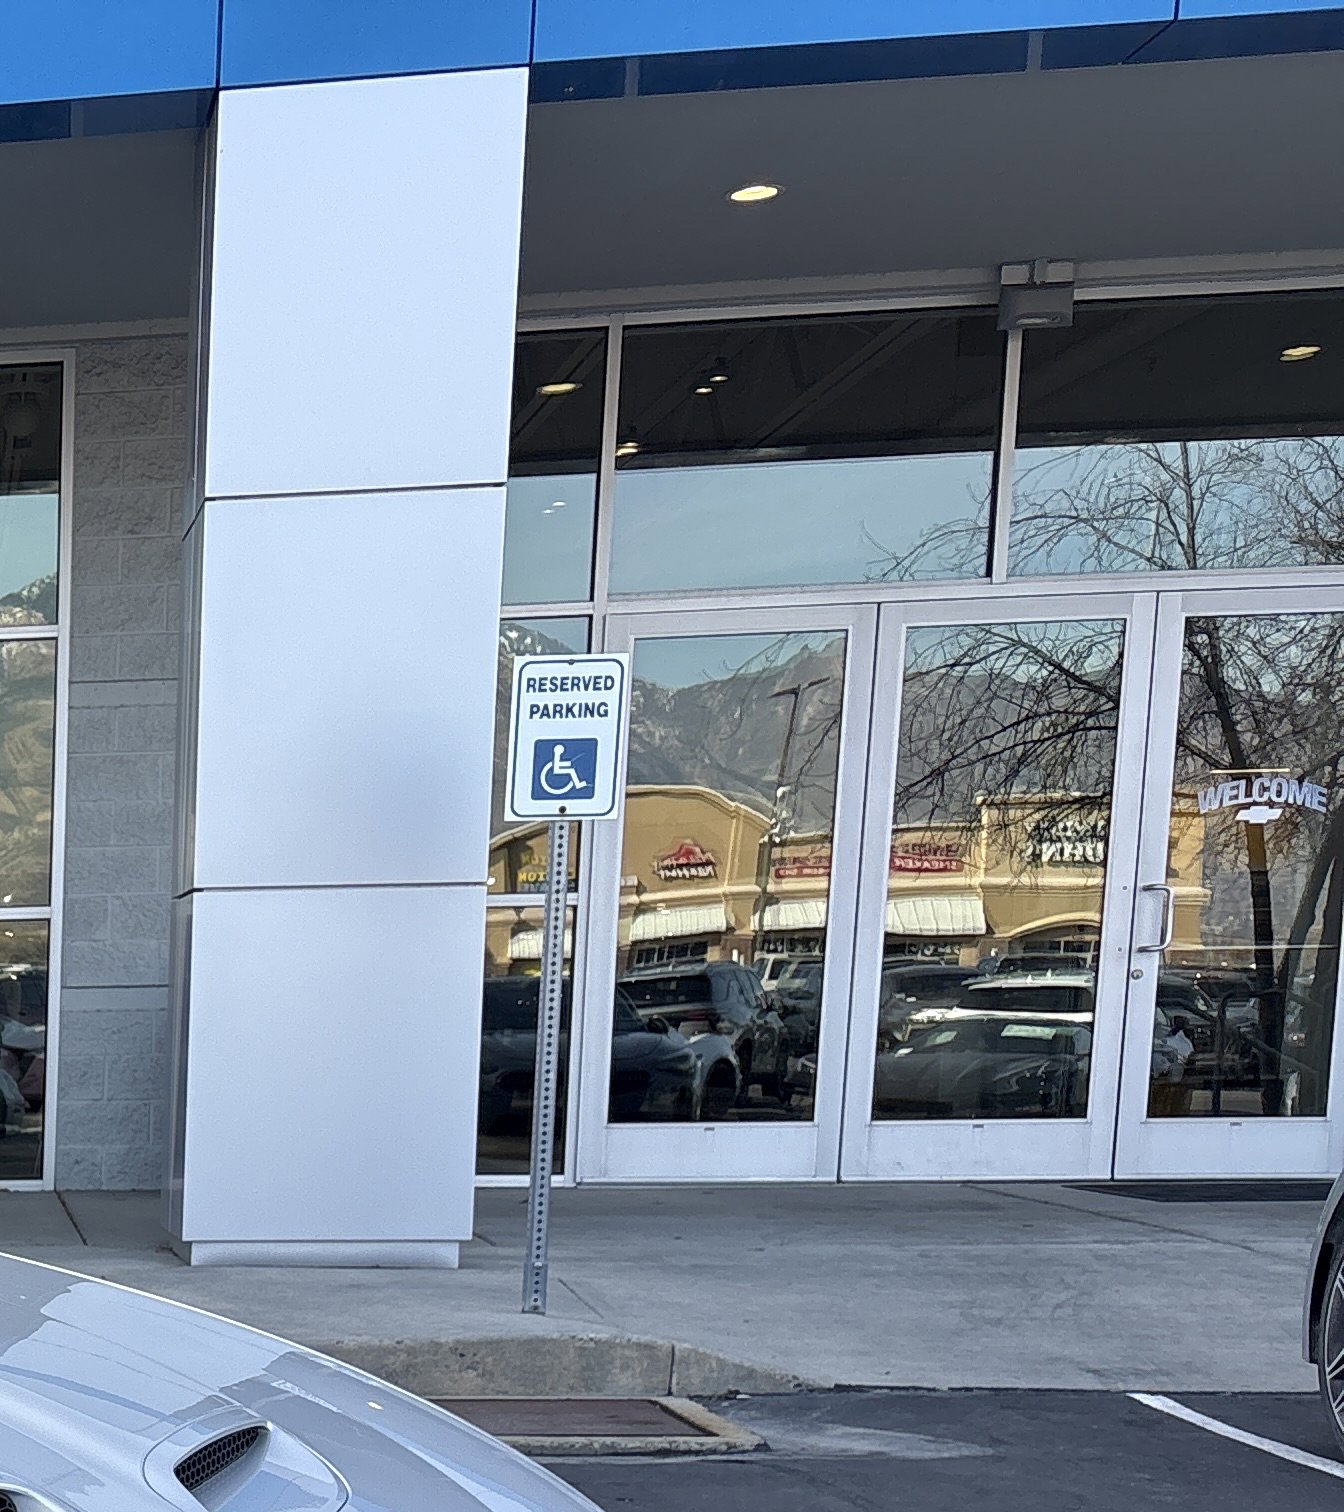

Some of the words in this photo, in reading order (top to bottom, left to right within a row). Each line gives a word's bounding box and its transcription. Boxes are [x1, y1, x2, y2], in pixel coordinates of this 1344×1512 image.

[526, 675, 614, 693] RESERVED
[529, 702, 609, 719] PARKING
[1198, 777, 1327, 814] WELCOME
